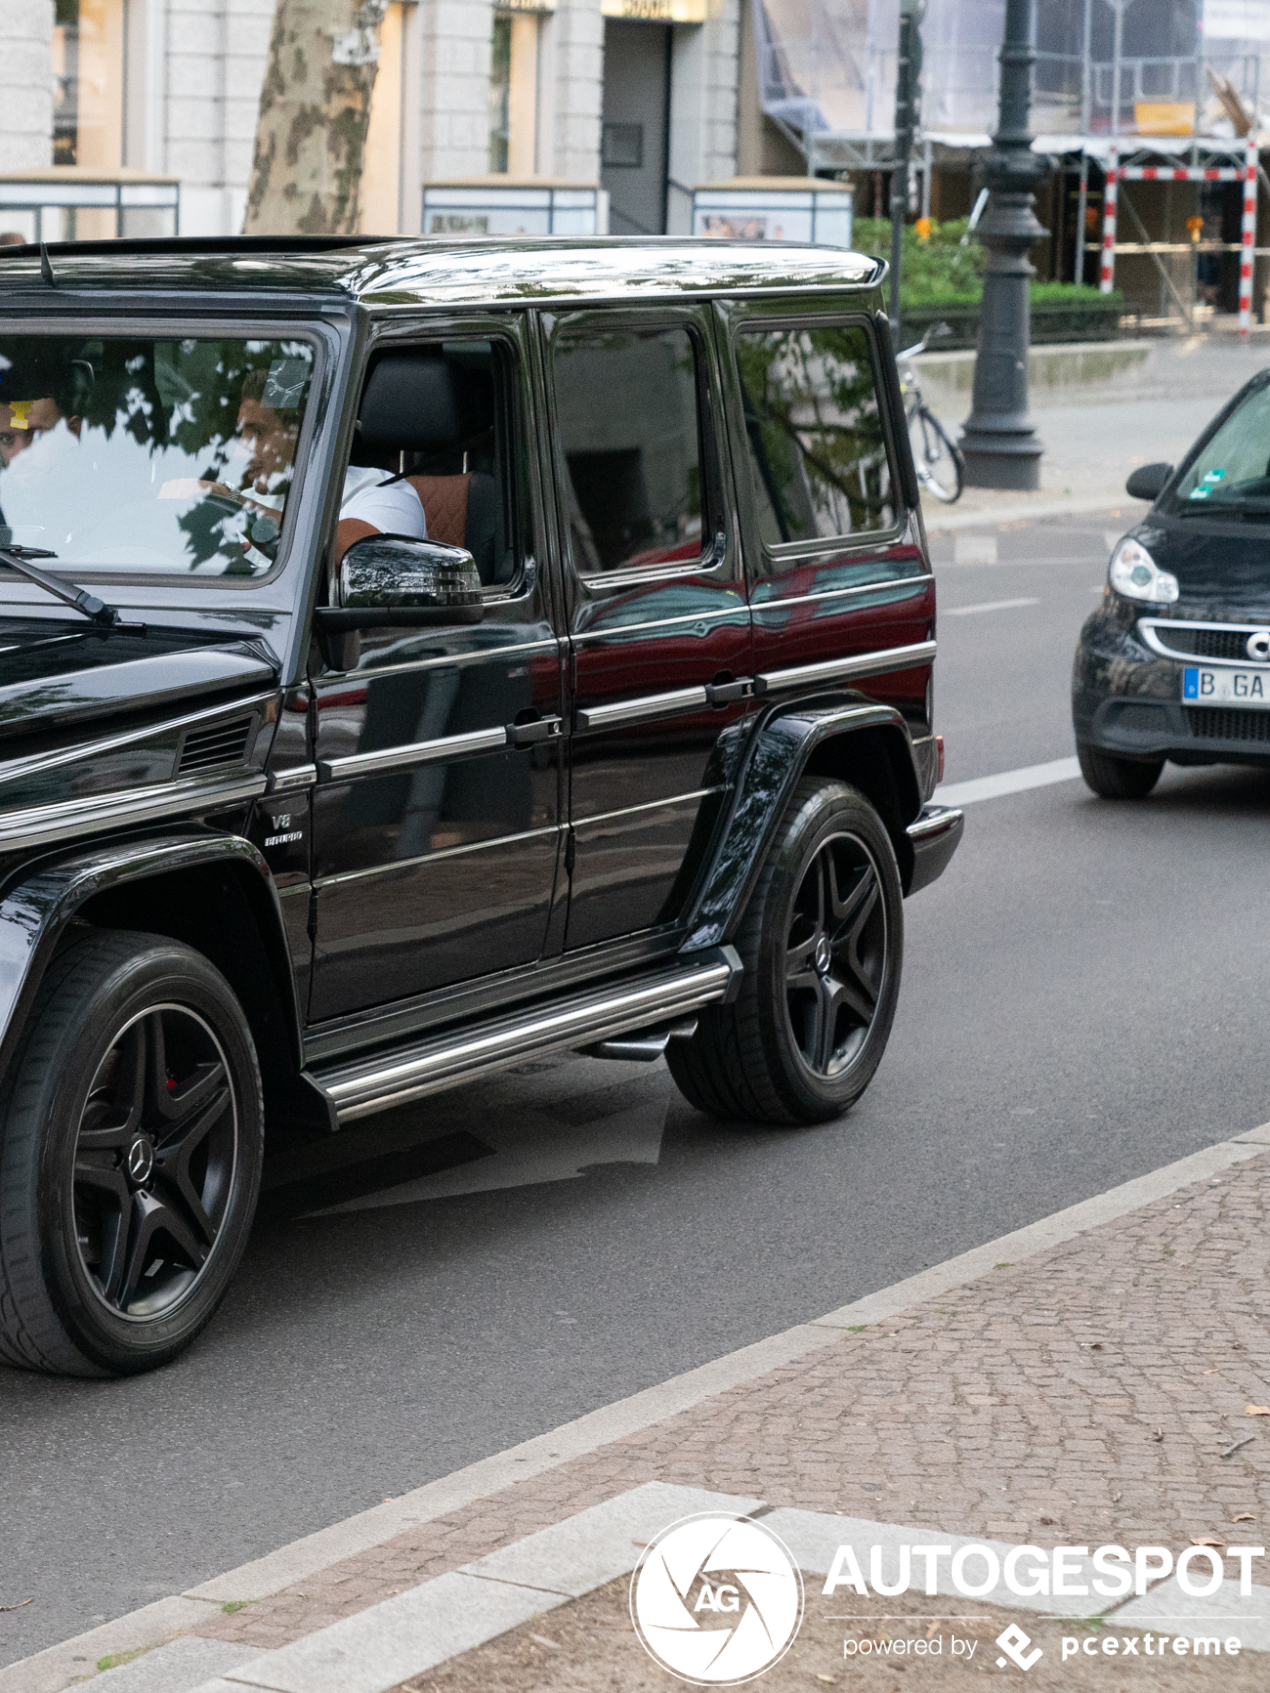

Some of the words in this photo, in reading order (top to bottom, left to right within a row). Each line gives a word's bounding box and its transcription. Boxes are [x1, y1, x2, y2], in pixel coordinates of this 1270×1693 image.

[1201, 673, 1215, 695] B
[1234, 674, 1264, 698] GA
[272, 813, 291, 830] V8
